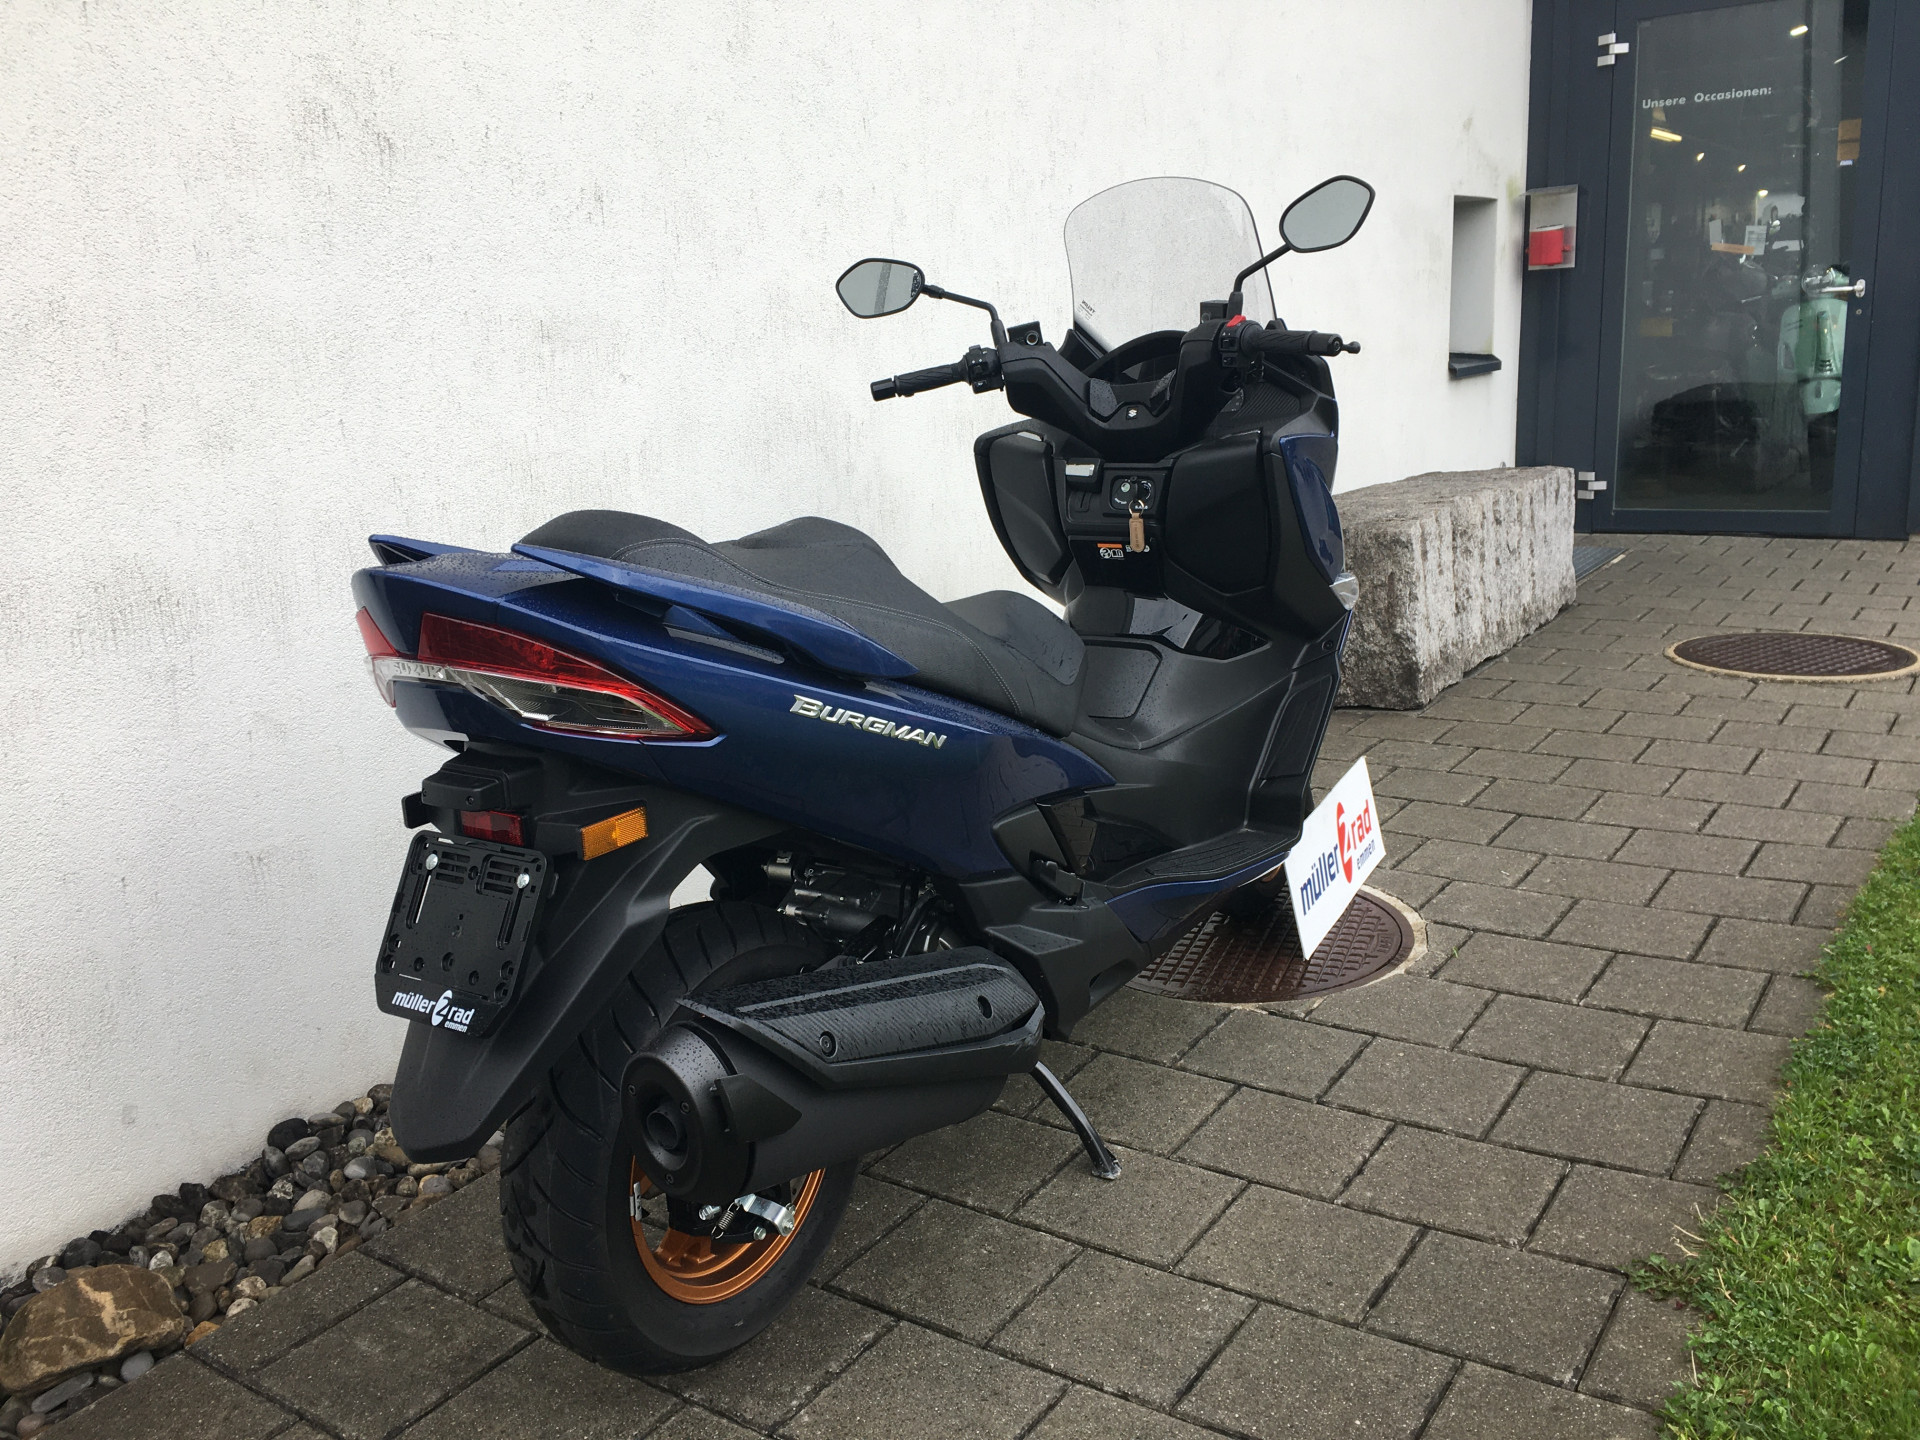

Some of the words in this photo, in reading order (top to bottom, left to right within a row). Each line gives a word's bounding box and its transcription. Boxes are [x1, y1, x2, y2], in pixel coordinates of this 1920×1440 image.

[1642, 95, 1687, 109] Unsere
[1694, 86, 1772, 103] Occasionen:
[1357, 839, 1376, 870] emmen
[444, 1020, 468, 1033] emmen
